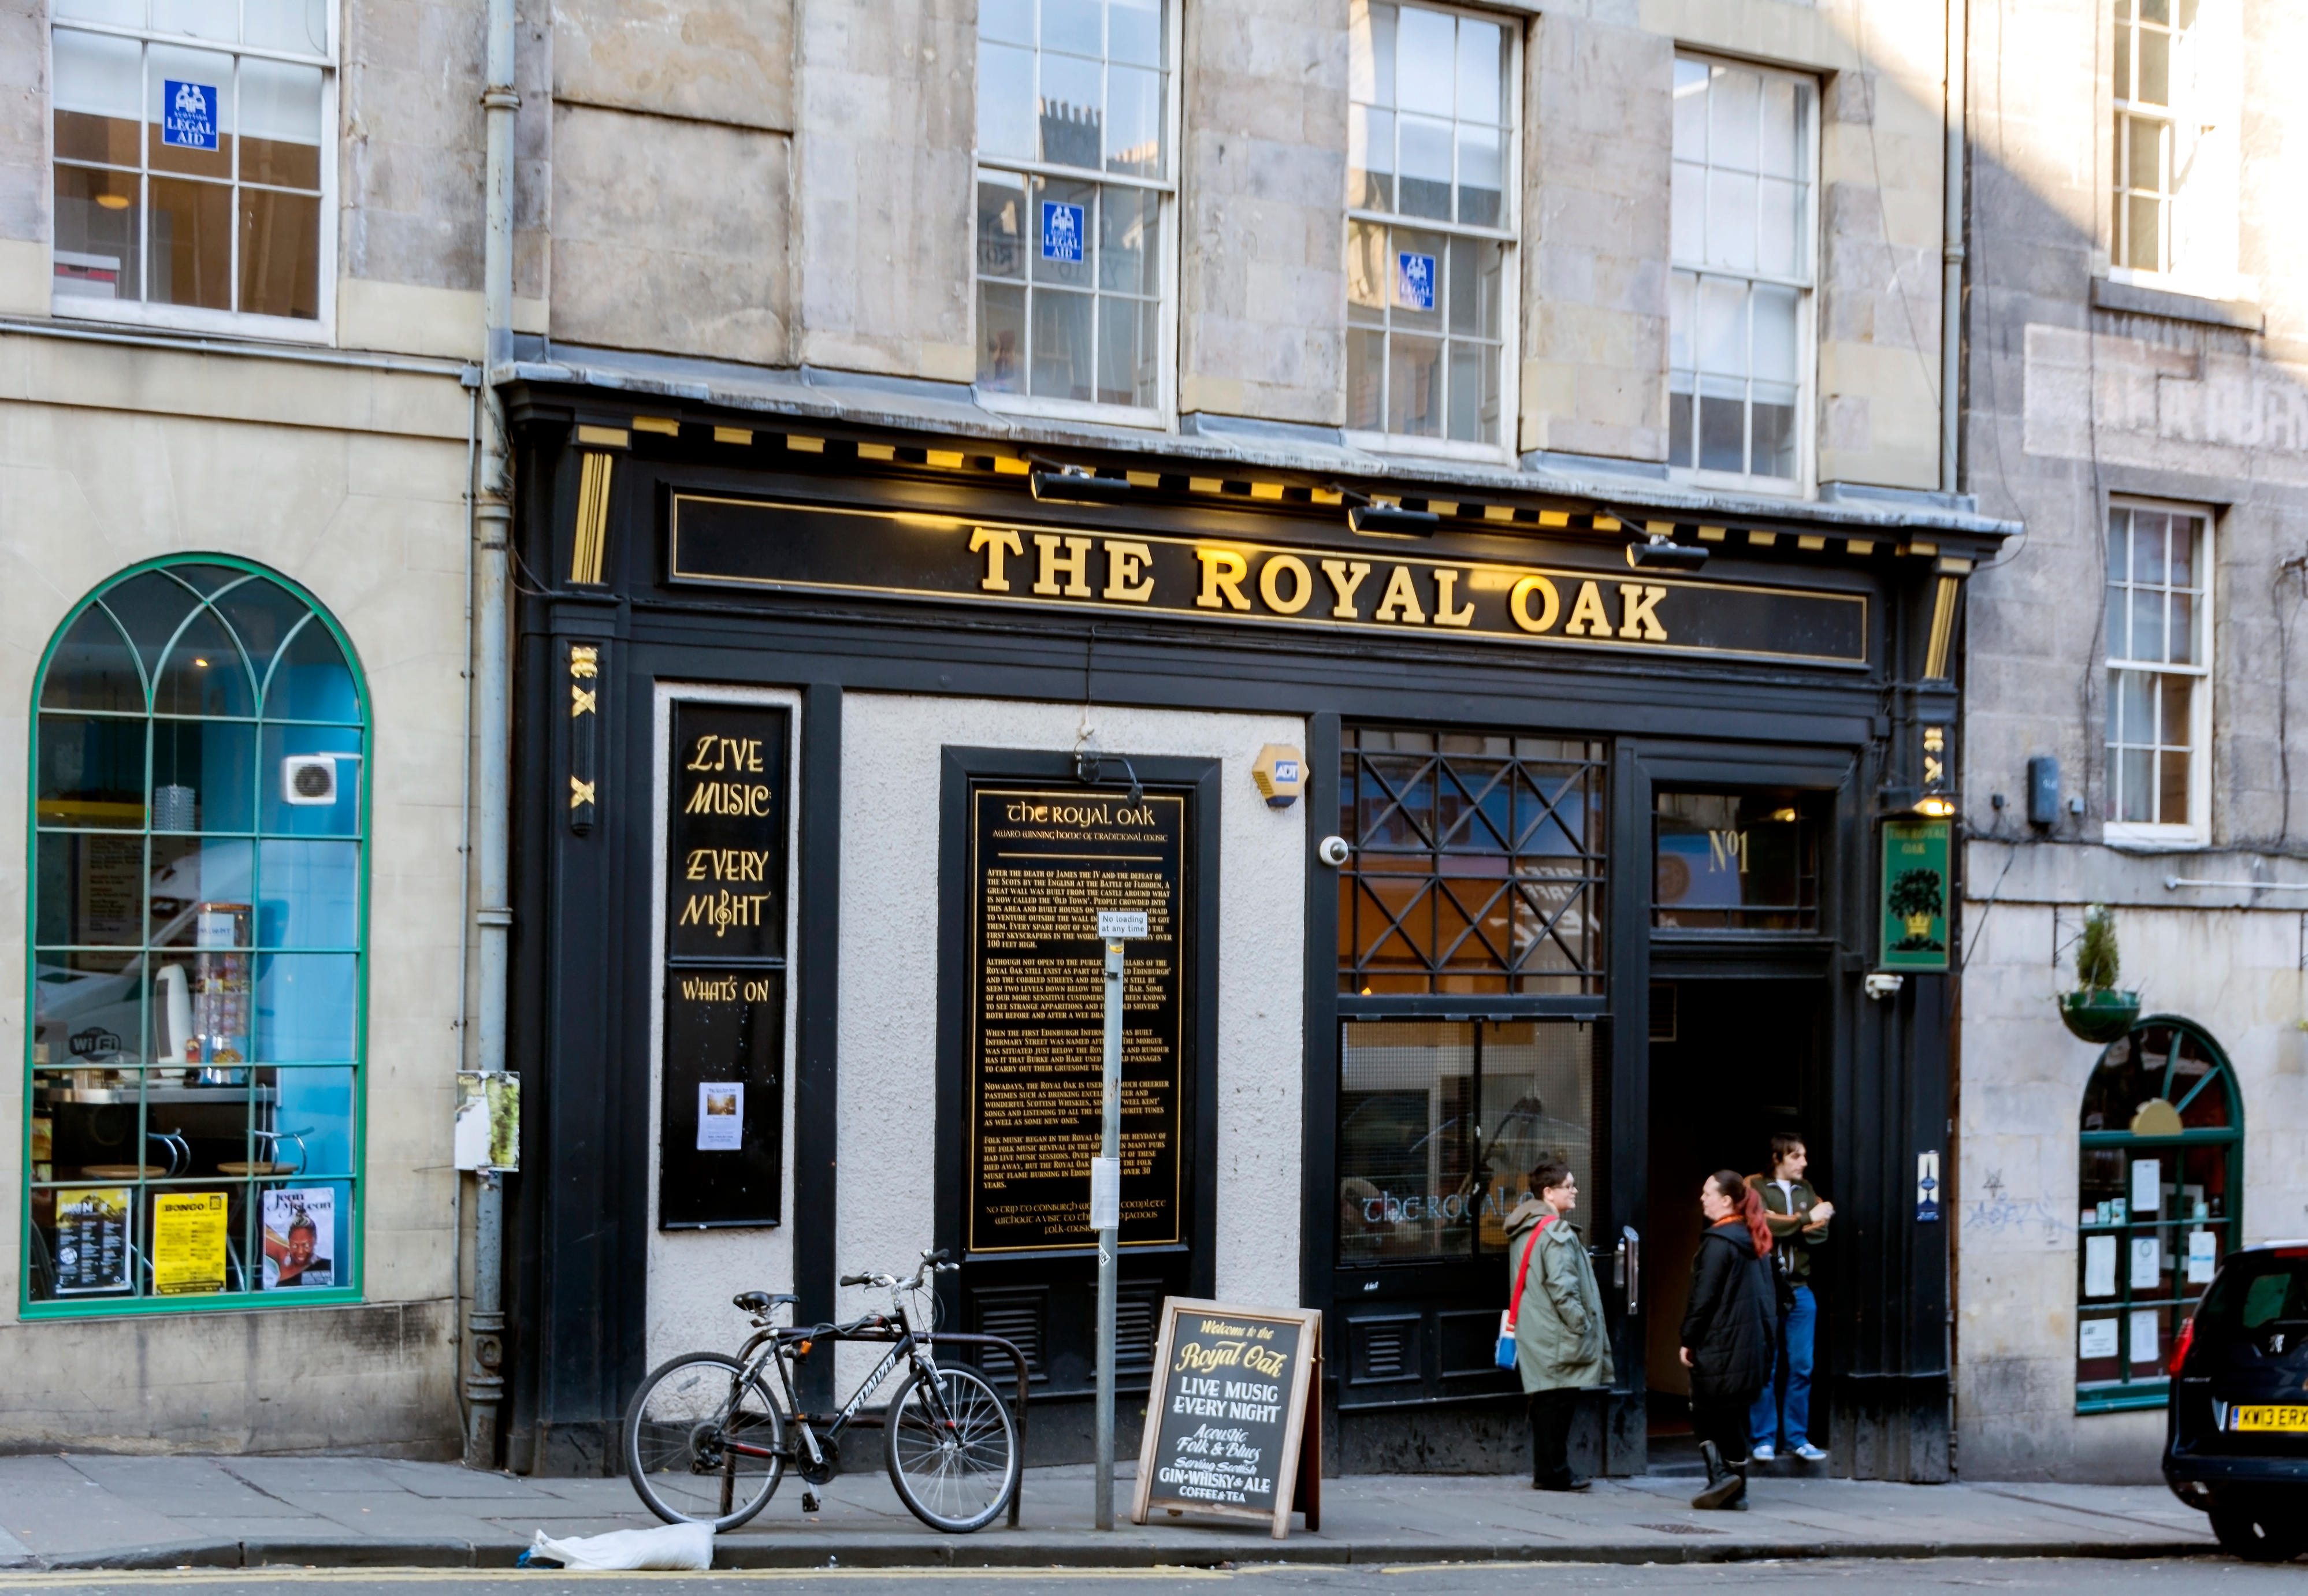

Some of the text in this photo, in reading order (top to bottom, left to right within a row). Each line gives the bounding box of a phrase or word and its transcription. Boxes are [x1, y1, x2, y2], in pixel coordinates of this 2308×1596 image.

[168, 116, 215, 135] LEGAL
[177, 131, 204, 145] AID
[1046, 234, 1080, 250] LEGAL
[1053, 245, 1073, 259] AID
[969, 526, 1667, 641] THE ROYAL OAK
[687, 735, 764, 773] LIVE
[1276, 763, 1298, 779] ADT
[685, 782, 770, 816] MUSIC
[686, 849, 769, 881] EVERY
[679, 890, 771, 937] NIGHT
[1103, 915, 1143, 925] No loading
[1112, 926, 1125, 934] any
[987, 939, 1000, 947] 100
[682, 974, 769, 1002] WHAT'S ON
[165, 1204, 204, 1212] BONGO
[1201, 1319, 1274, 1341] Welcome to the
[1175, 1341, 1288, 1378] Royal Oak
[844, 1353, 896, 1418] SPECIALIZED
[1181, 1376, 1278, 1403] LIVE MUSIC
[1173, 1396, 1282, 1423] EVERY NIGHT
[2242, 1408, 2308, 1425] KW13 ERX
[1193, 1423, 1250, 1442] Acoustic
[1177, 1436, 1262, 1465] Folk & Blues
[1174, 1456, 1257, 1475] Serving Scottish
[1243, 1476, 1271, 1493] ALE
